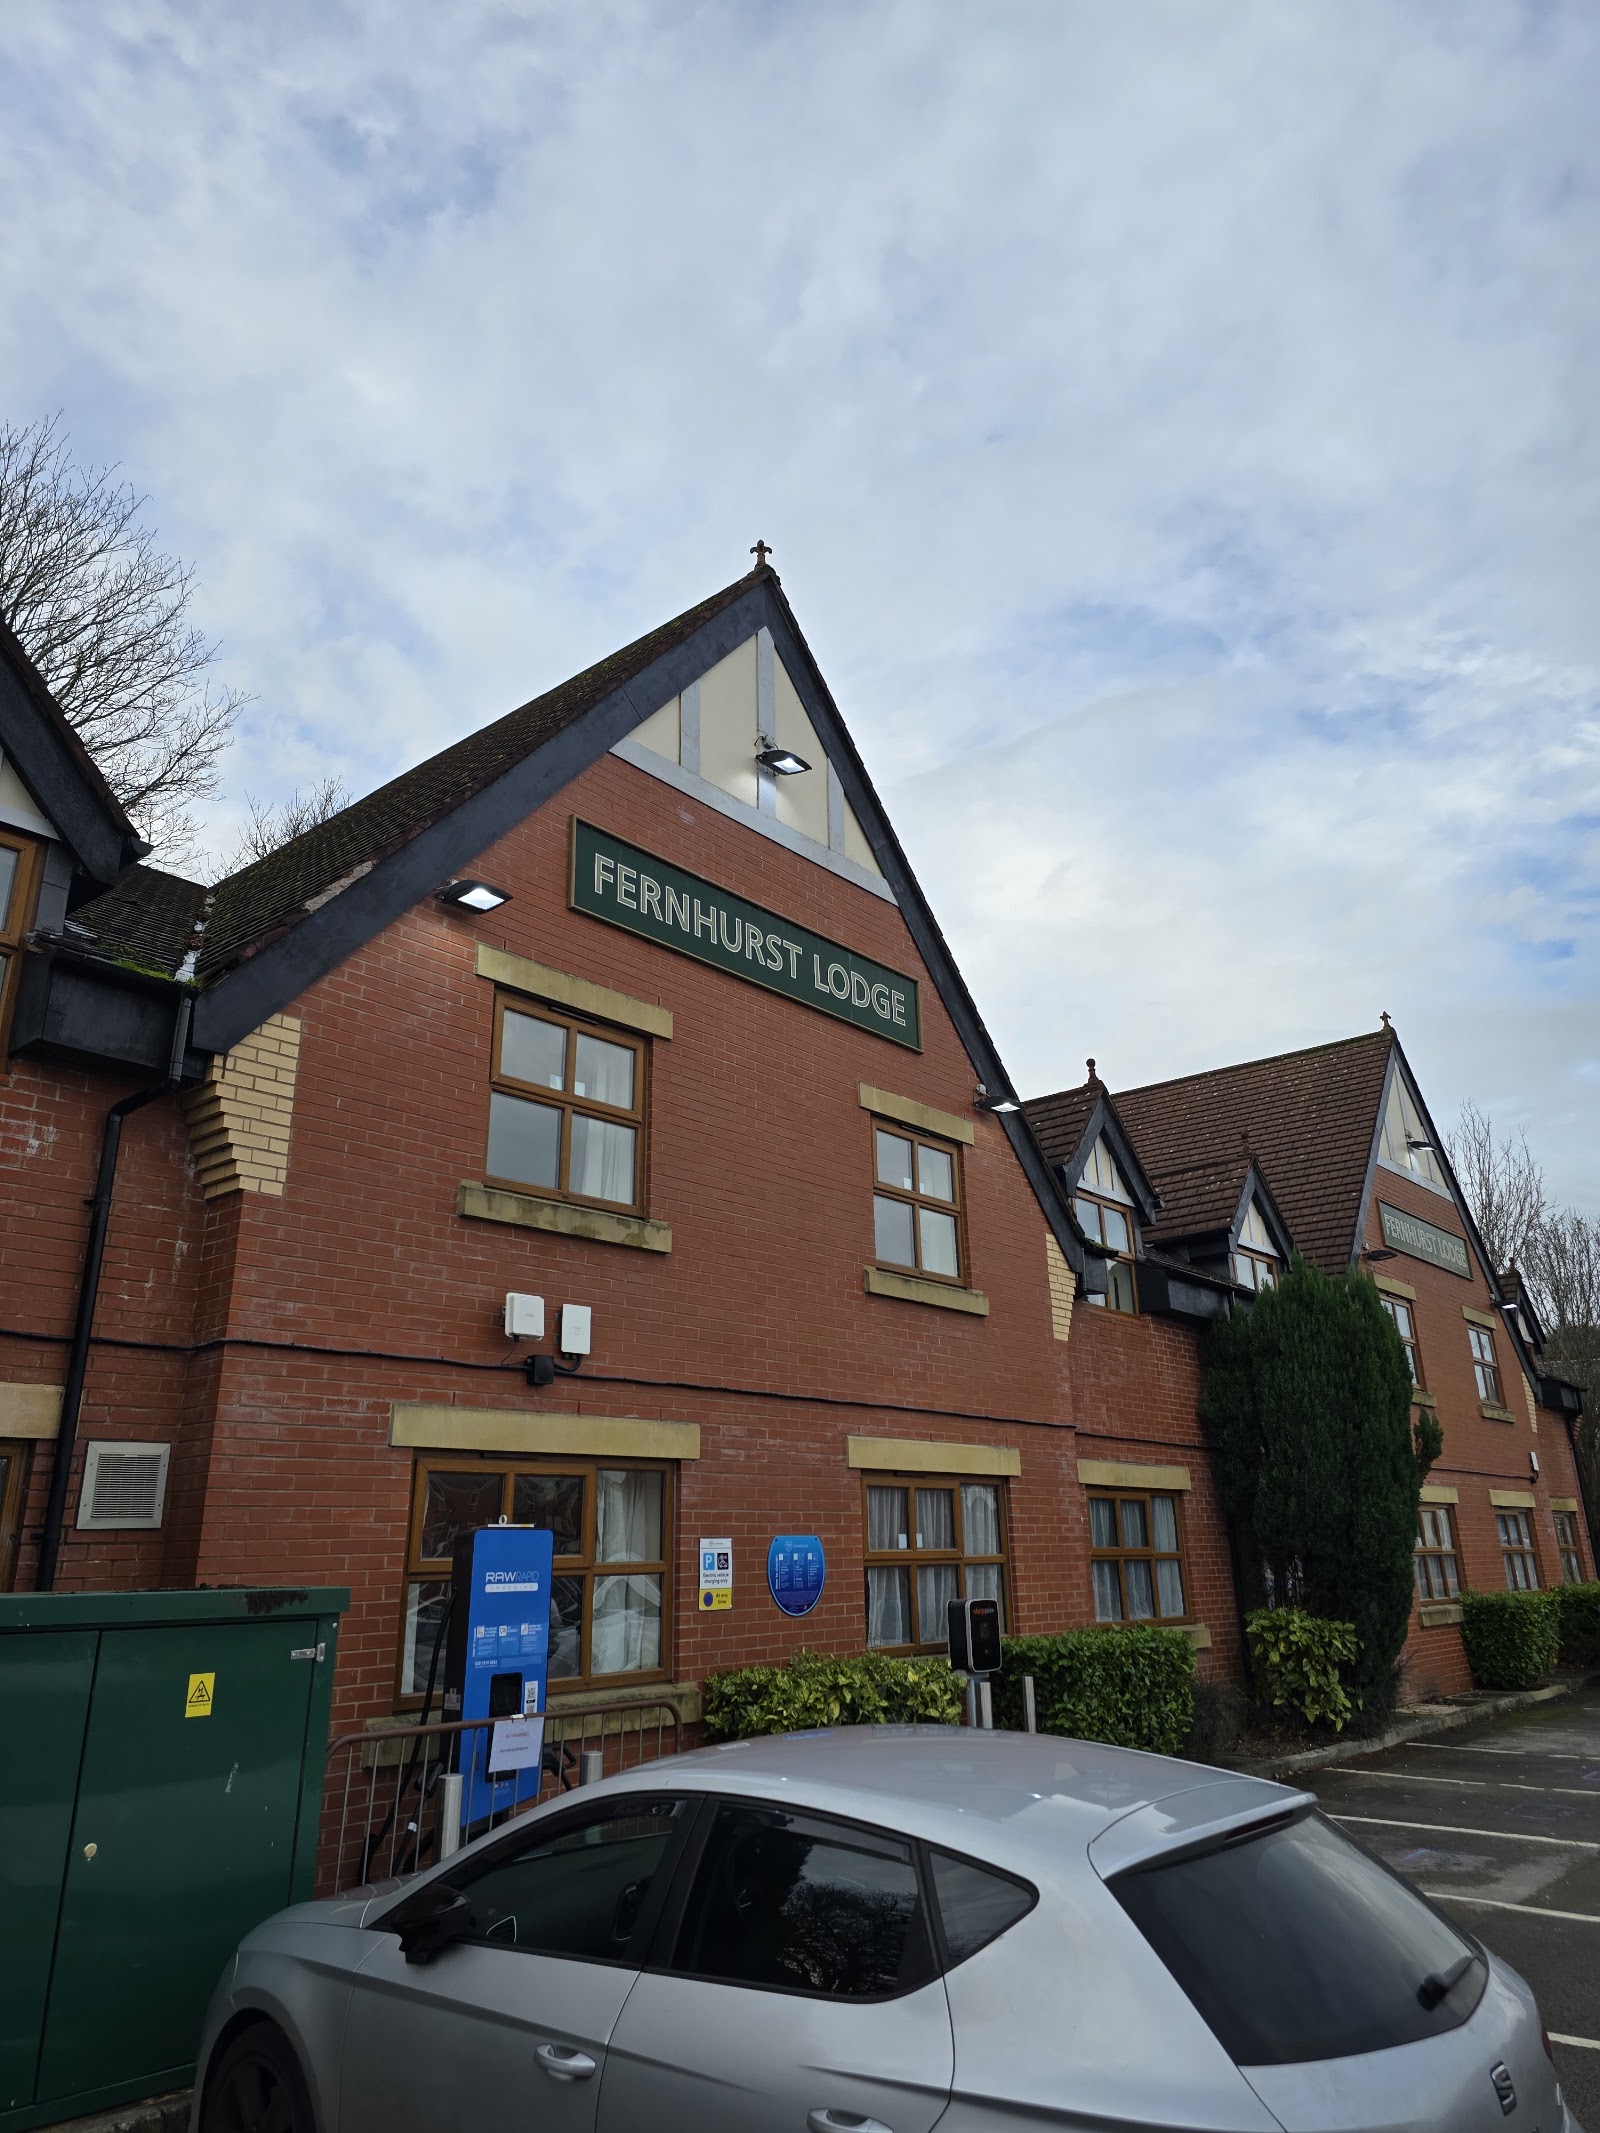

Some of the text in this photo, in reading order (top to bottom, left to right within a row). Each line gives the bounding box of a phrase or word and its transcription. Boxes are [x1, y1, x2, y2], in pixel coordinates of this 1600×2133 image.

[594, 852, 907, 1027] FERNHURST LODGE
[1383, 1213, 1467, 1268] FERNHURST LODGE
[705, 1554, 713, 1569] P
